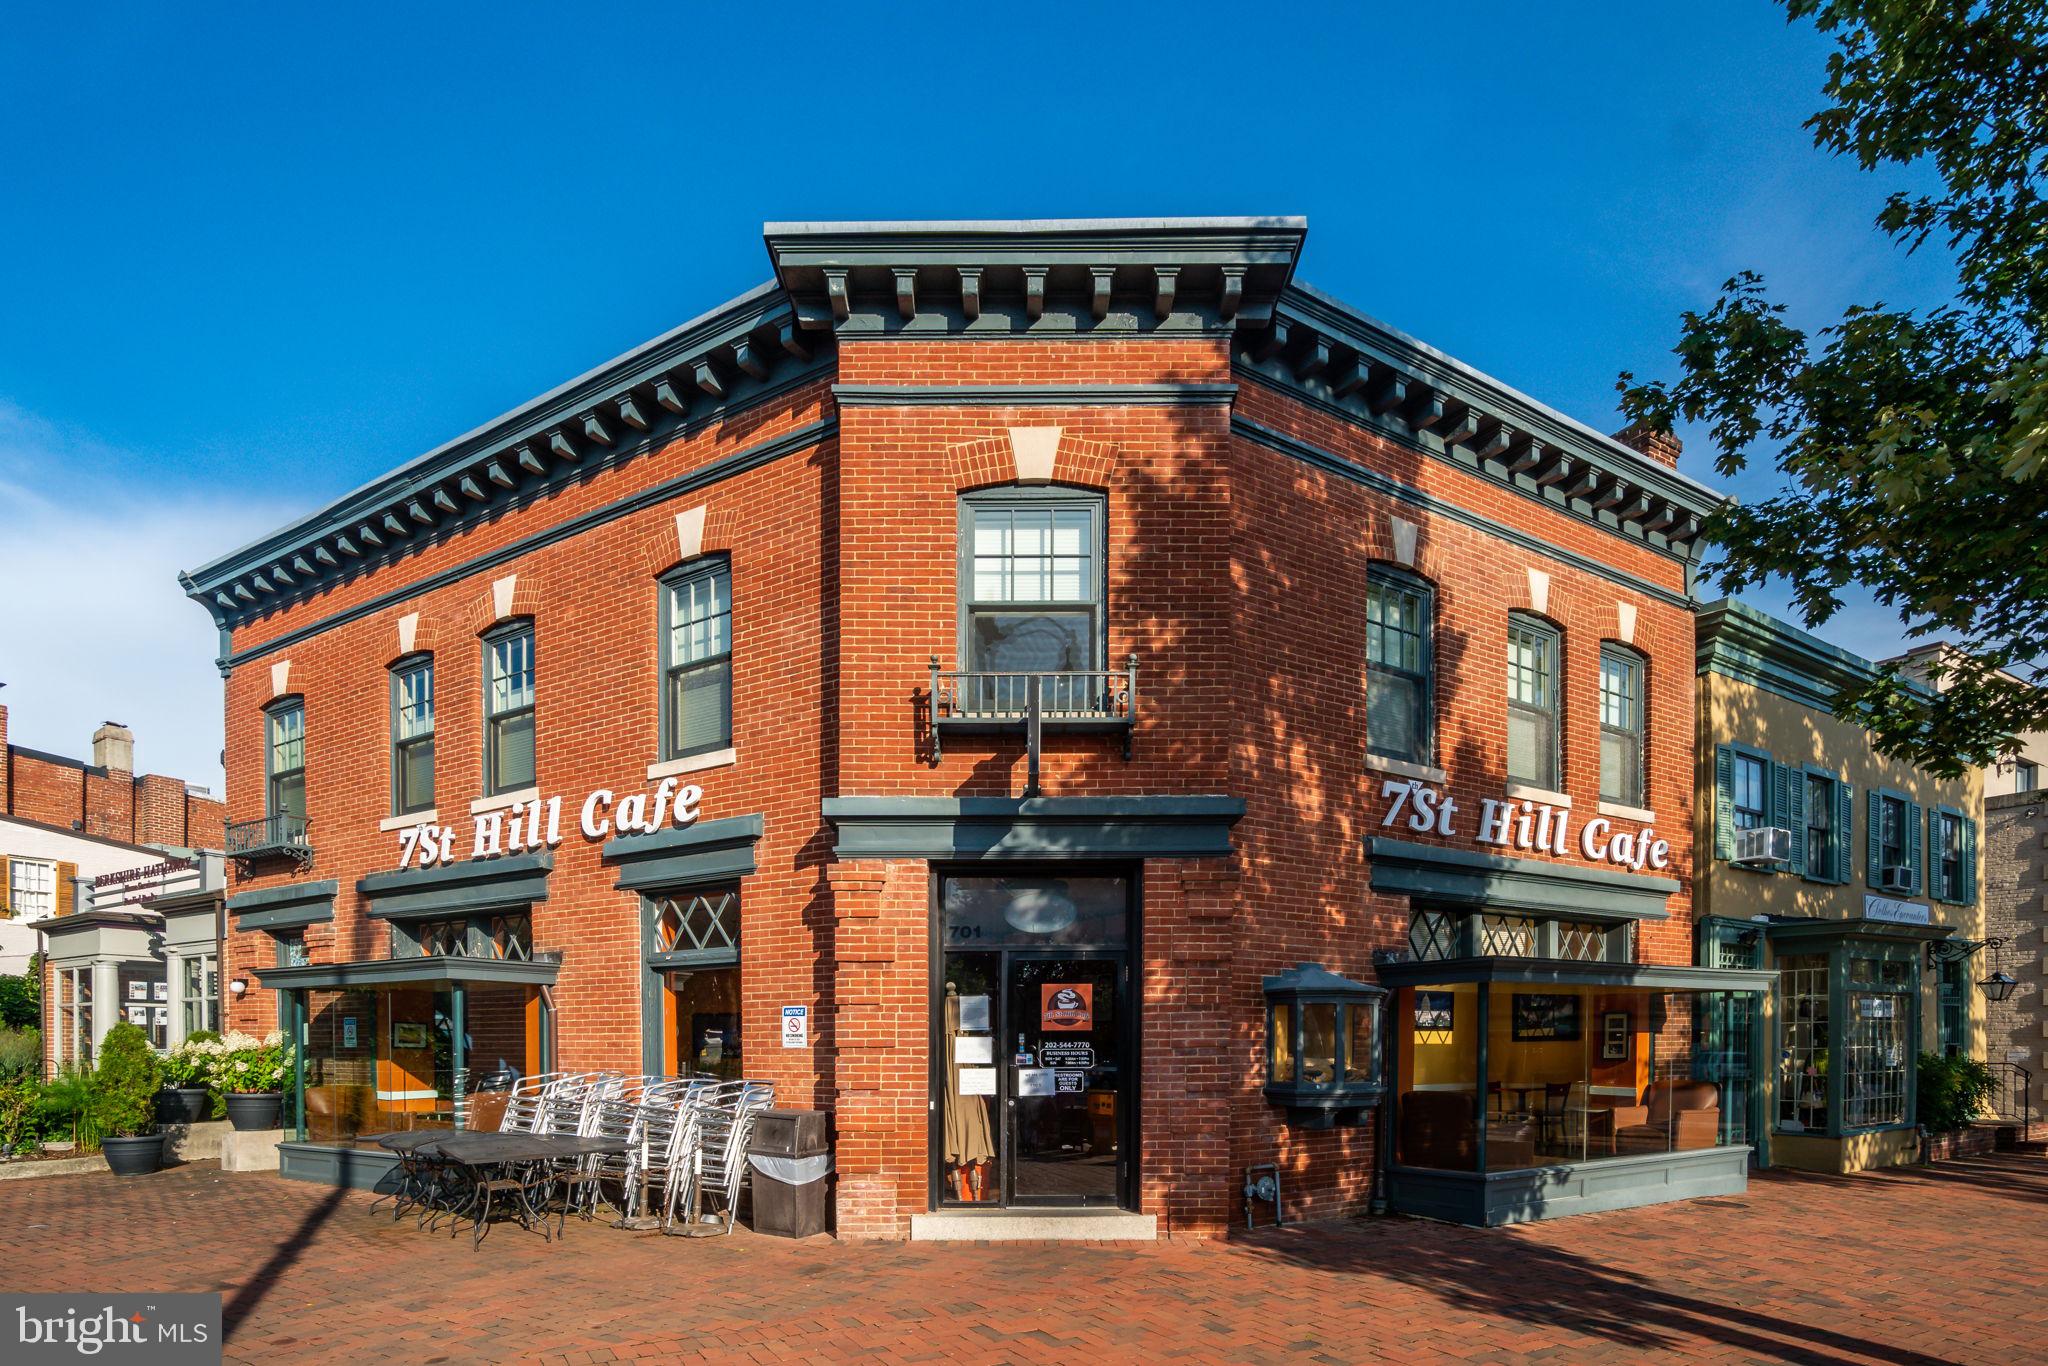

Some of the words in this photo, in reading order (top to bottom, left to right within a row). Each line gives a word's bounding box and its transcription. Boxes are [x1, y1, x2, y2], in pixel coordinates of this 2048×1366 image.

[471, 796, 563, 858] Hill
[580, 777, 704, 838] Cafe
[1476, 798, 1569, 855] Hill
[1581, 818, 1668, 870] Cafe
[95, 867, 141, 888] BERKSHIRE
[949, 926, 981, 938] 701
[784, 1008, 805, 1016] NOTICE
